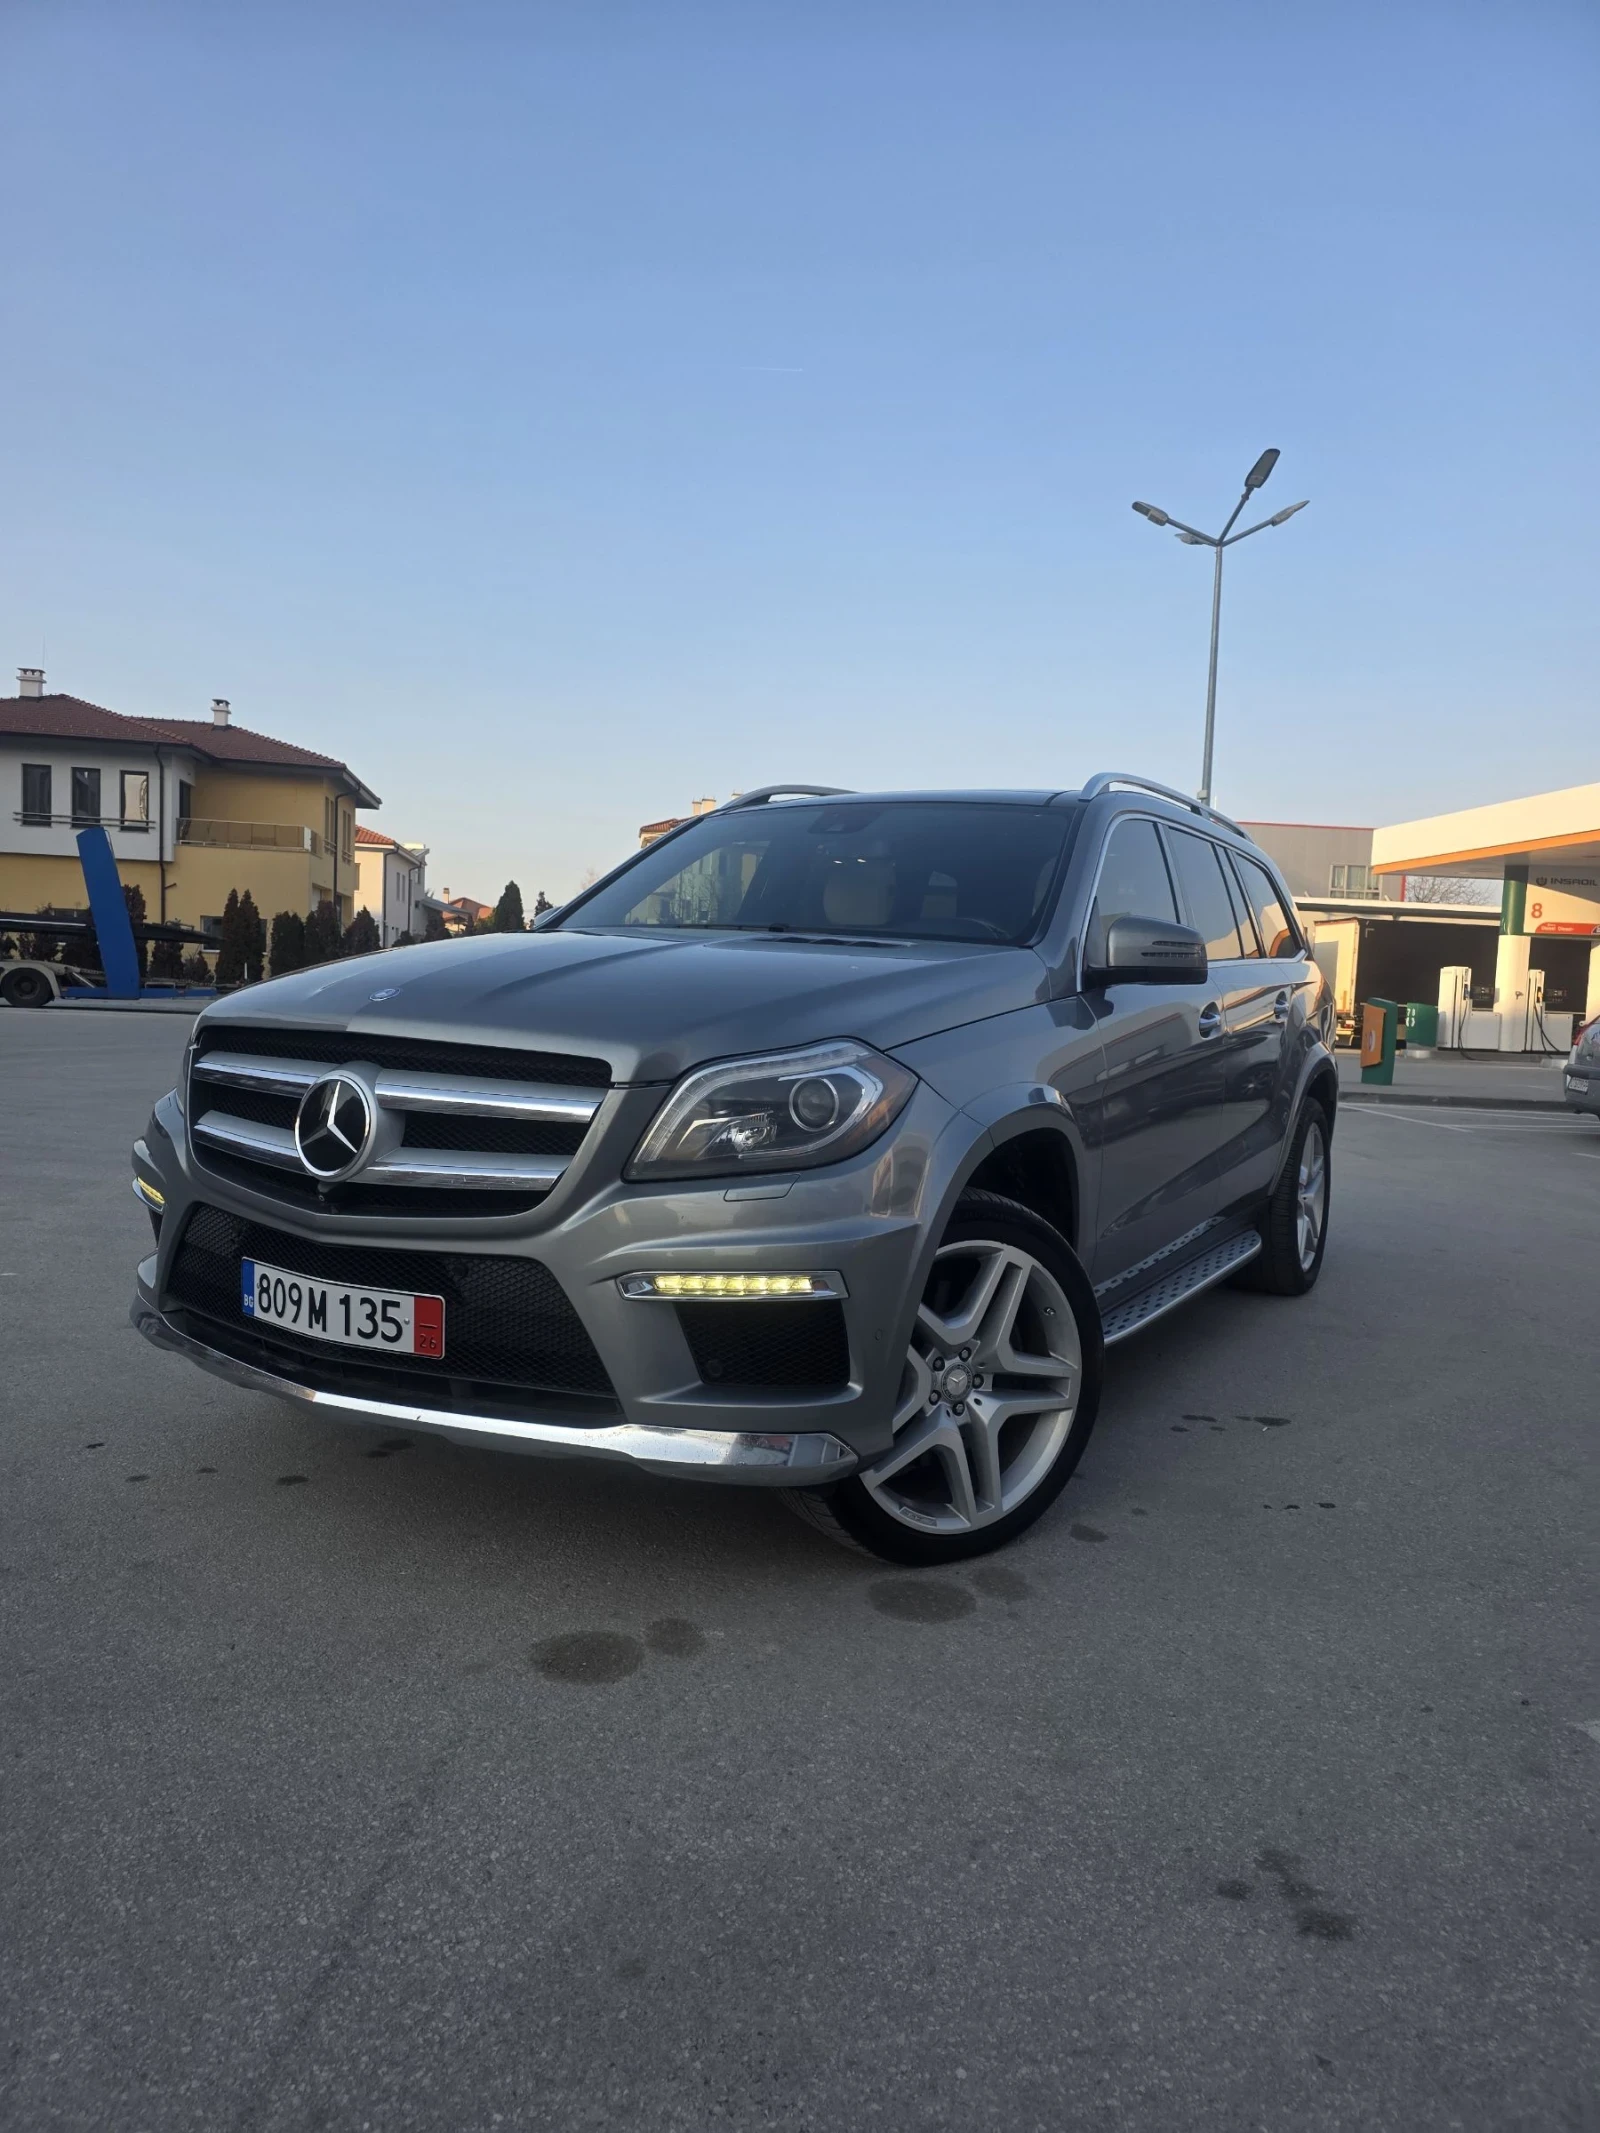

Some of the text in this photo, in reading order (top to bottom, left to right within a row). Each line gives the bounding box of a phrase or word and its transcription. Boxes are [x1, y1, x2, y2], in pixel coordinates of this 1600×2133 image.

[1550, 877, 1598, 886] INSAOIL
[1531, 903, 1543, 918] 8
[243, 1293, 254, 1308] BG
[258, 1273, 403, 1343] 809 M 135
[419, 1333, 437, 1349] 26
